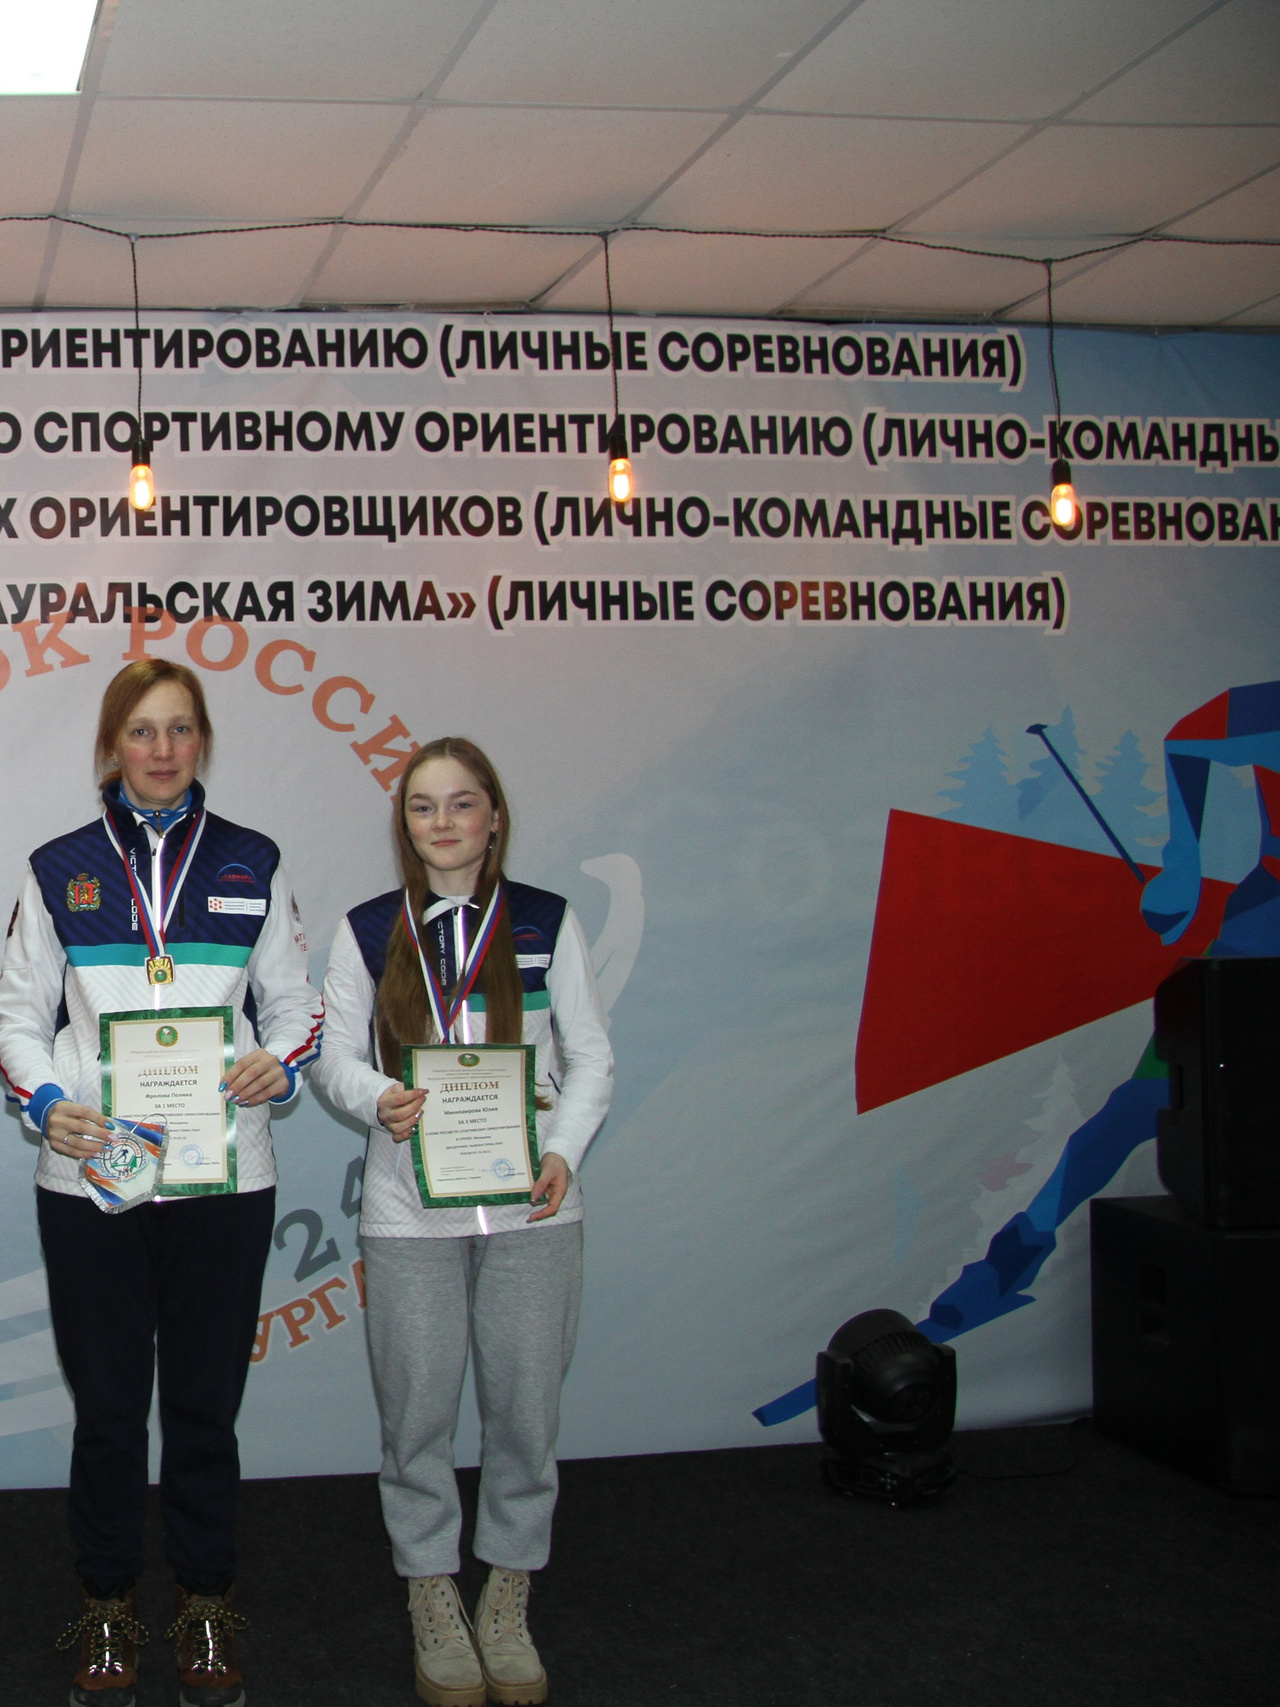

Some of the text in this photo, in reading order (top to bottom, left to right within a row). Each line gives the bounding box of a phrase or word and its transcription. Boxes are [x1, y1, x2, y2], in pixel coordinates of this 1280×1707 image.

[440, 327, 647, 381] (ЛИЧНЫЕ
[658, 330, 1022, 387] СОРЕВНОВАНИЯ)
[34, 410, 404, 453] СПОРТИВНОМУ
[415, 412, 854, 458] ОРИЕНТИРОВАНИЮ
[30, 494, 521, 541] ОРИЕНТИРОВЩИКОВ
[533, 491, 1013, 546] (ЛИЧНО-КОМАНДНЫЕ
[308, 578, 477, 621] ЗИМА»
[487, 574, 693, 629] (ЛИЧНЫЕ
[704, 579, 1067, 632] СОРЕВНОВАНИЯ)
[123, 606, 423, 802] РОССИ
[138, 1065, 199, 1077] ДИПЛОМ
[140, 1080, 197, 1088] НАГРАЖДАЕТСЯ
[440, 1081, 499, 1094] ДИПЛОМ
[442, 1094, 498, 1104] НАГРАЖДАЕТСЯ
